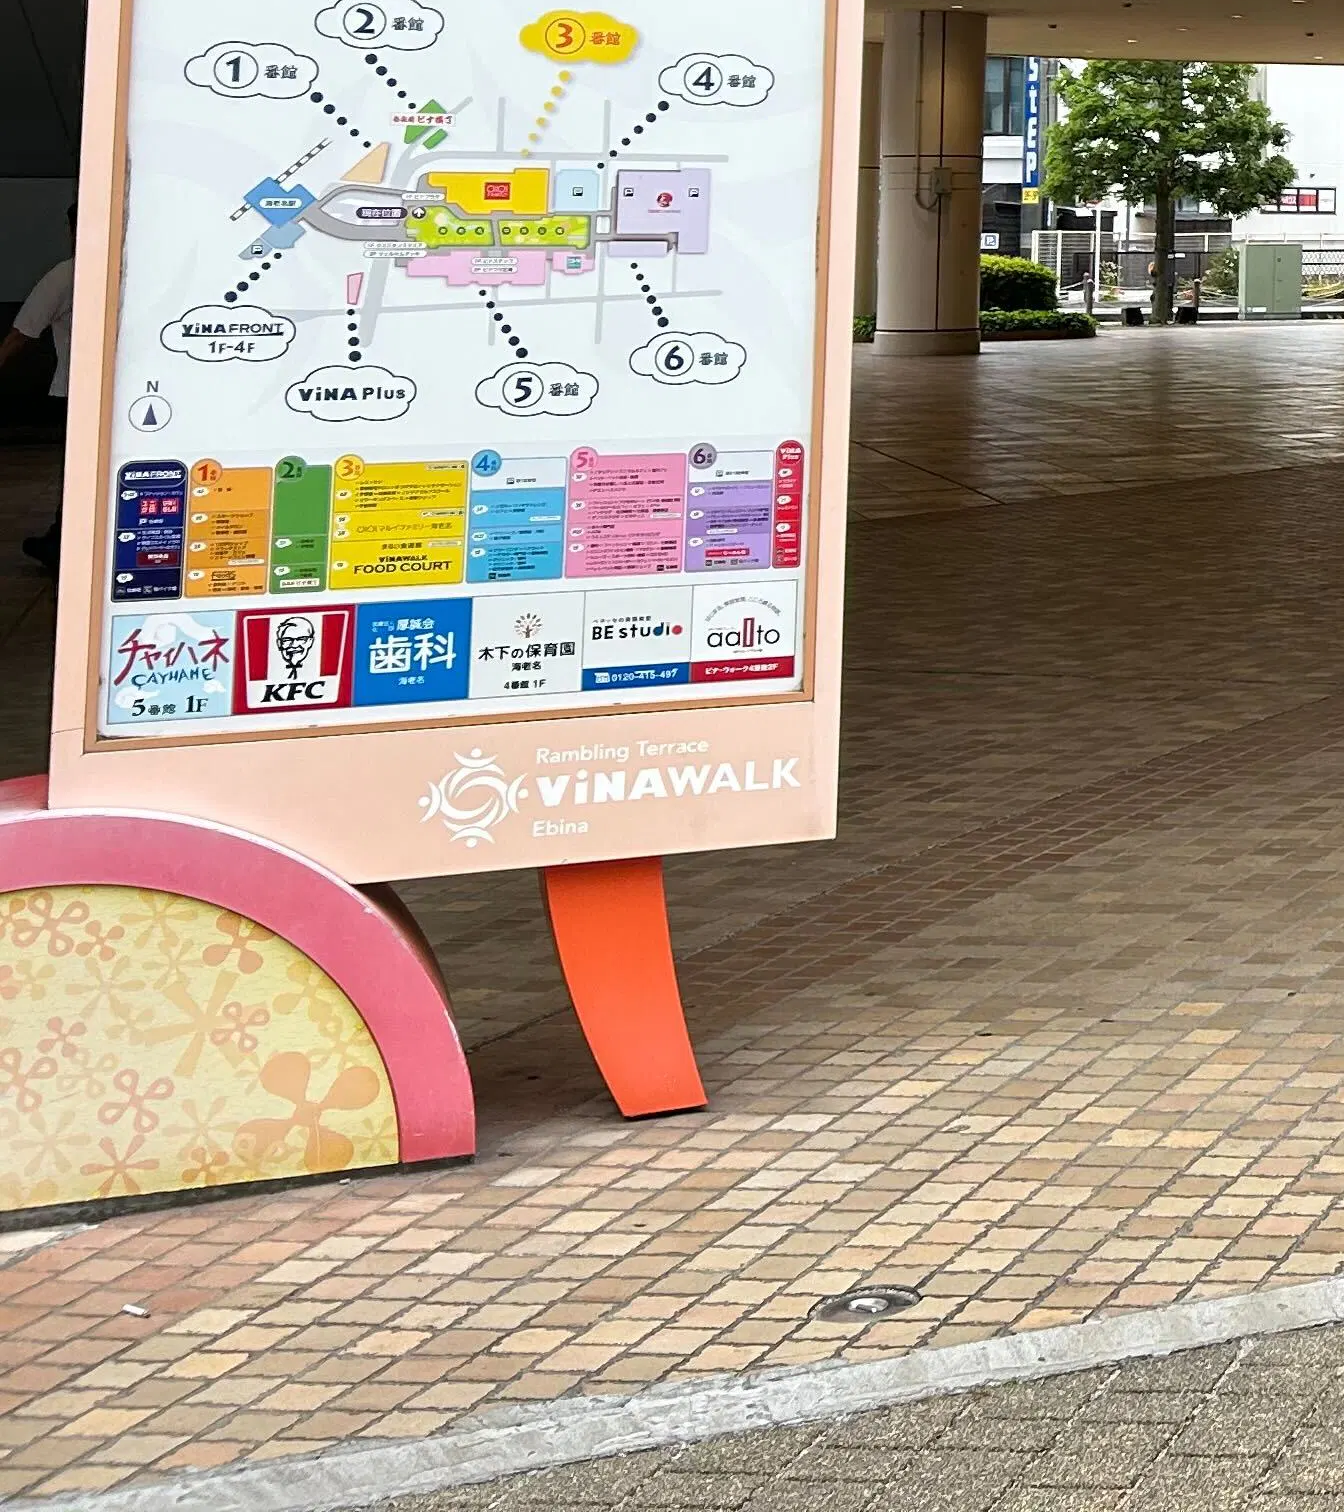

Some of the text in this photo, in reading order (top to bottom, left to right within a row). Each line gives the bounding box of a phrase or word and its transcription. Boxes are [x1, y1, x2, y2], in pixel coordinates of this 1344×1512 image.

[208, 342, 255, 354] 1F-4F
[147, 381, 159, 392] N
[362, 387, 406, 400] Plus
[353, 561, 452, 575] FOOD COURT
[592, 622, 683, 640] BE studio
[114, 628, 230, 686] チャイハネ
[369, 632, 456, 674] 歯科
[478, 641, 576, 662] 木下の保育園
[261, 681, 325, 704] KFC
[533, 679, 547, 688] 1F
[185, 696, 209, 714] 1F
[536, 739, 709, 765] Rambling Terrace
[533, 819, 589, 838] Ebina
